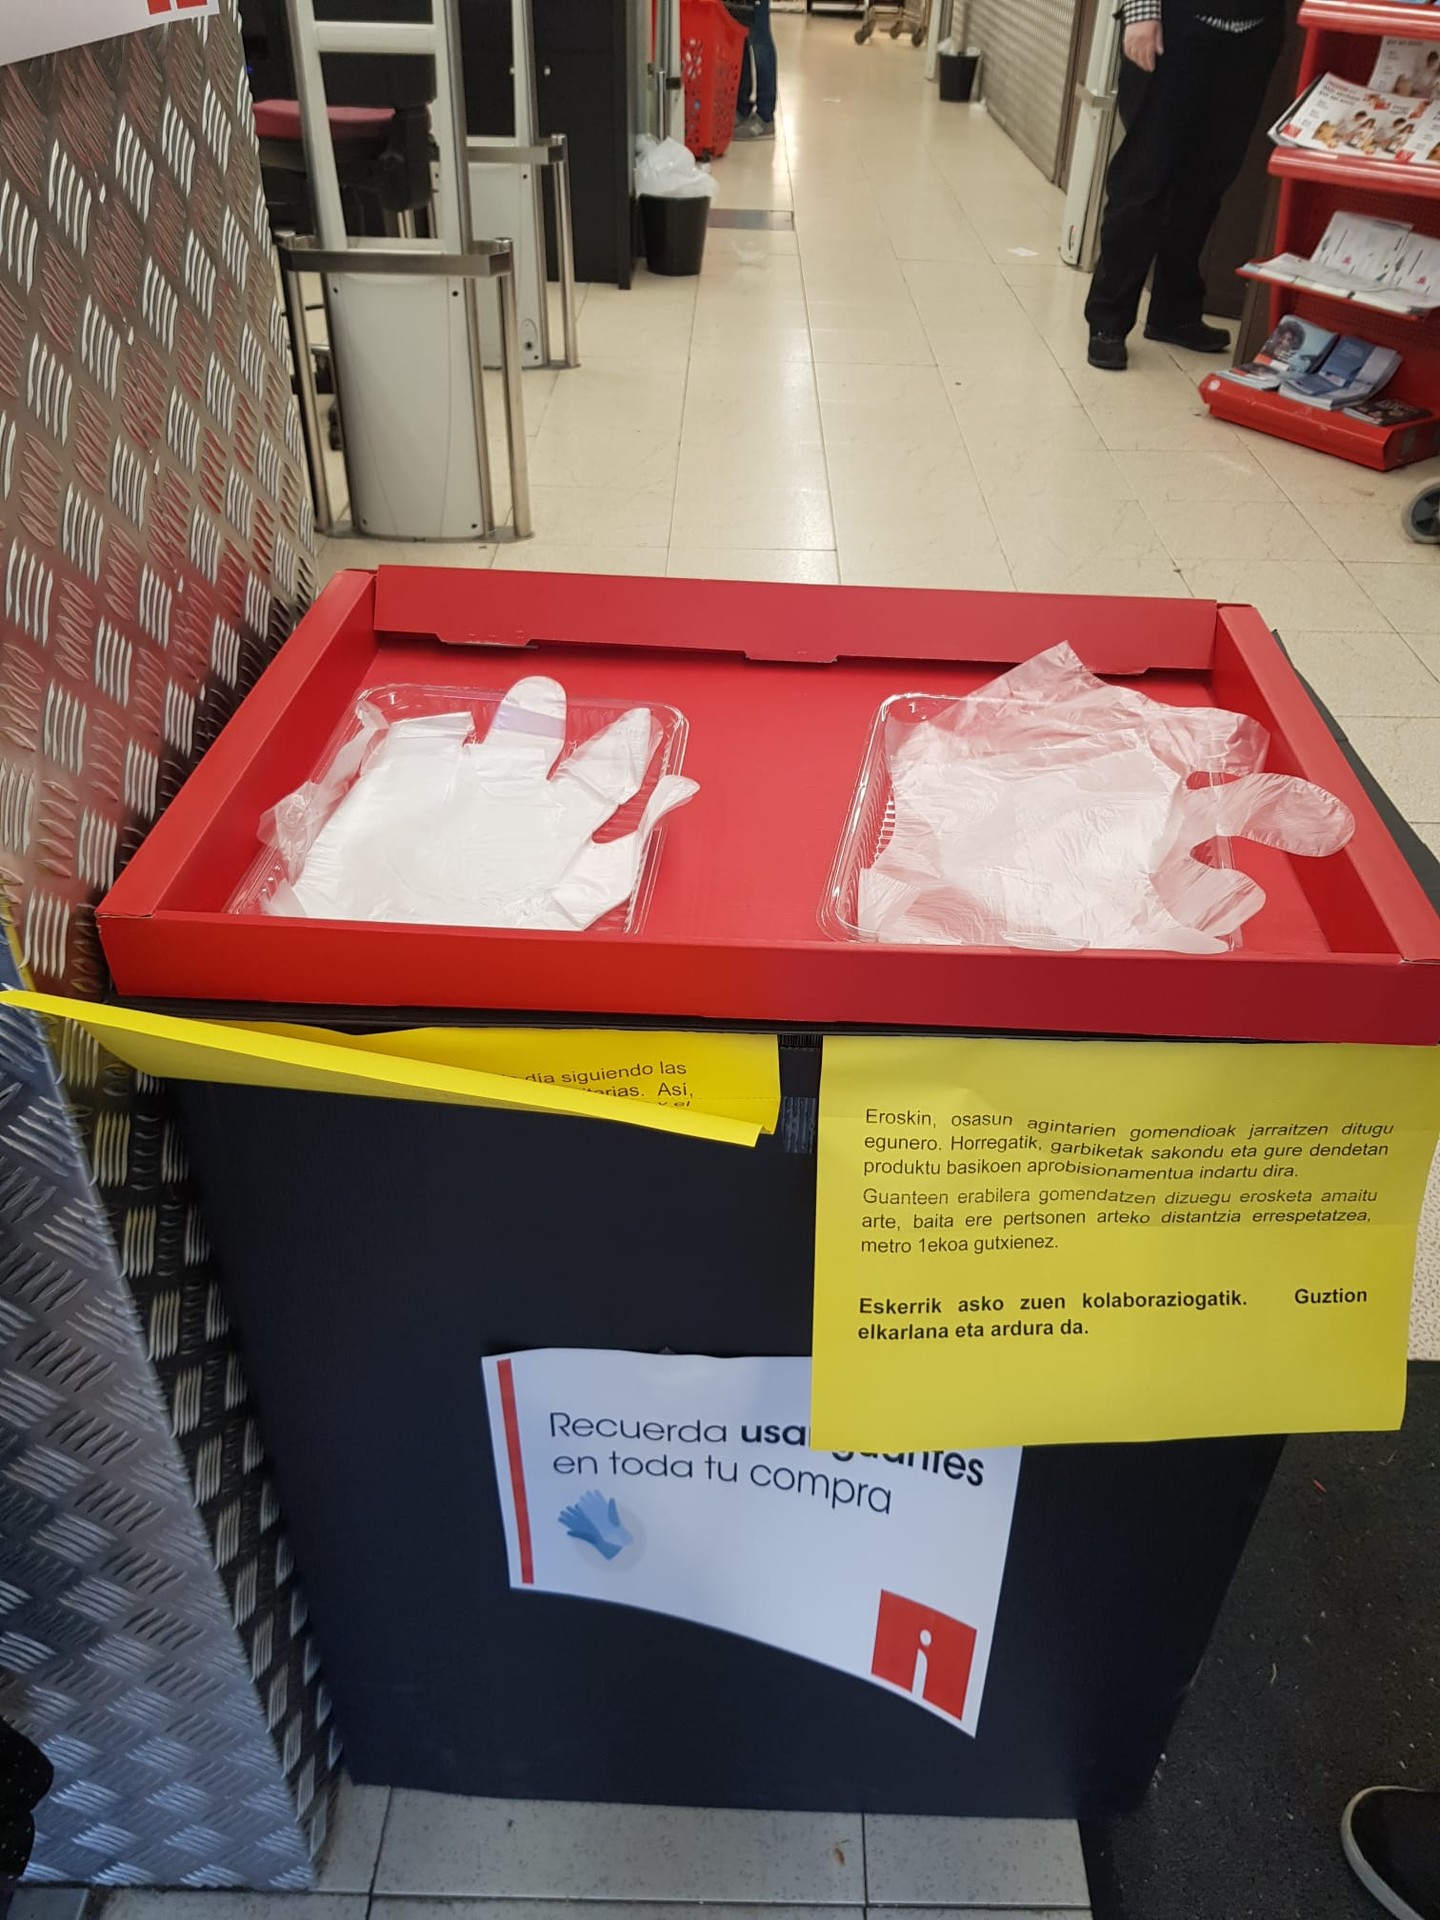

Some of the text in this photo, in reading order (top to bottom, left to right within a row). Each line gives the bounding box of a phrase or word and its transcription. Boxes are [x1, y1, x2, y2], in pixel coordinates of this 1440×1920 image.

[561, 1063, 654, 1085] siguiendo
[659, 1061, 687, 1075] las
[865, 1108, 1395, 1143] Eroskin, osasun agintarien gomendioak jarraitzen ditugu
[864, 1134, 1389, 1161] egunero. Horregatik, garbiketak sakondu eta gure dendetan
[863, 1158, 1299, 1181] produktu basikoen aprobisionamentua indartu dira.
[862, 1187, 1378, 1207] Guanteen erabilera gomendatzen dizuegu erosketa amaitu
[861, 1209, 1371, 1232] arte, baita ere pertsonen arteko distantzia errespetatzea,
[861, 1235, 1059, 1255] metro 1ekoa gutxienez.
[859, 1287, 1368, 1315] Eskerrik asko zuen kolaboraziogatik. Guztion
[857, 1318, 1089, 1341] elkarlana eta ardura da.
[550, 1412, 728, 1444] Recuerda
[740, 1423, 812, 1448] usa
[553, 1450, 892, 1515] en toda tu compra
